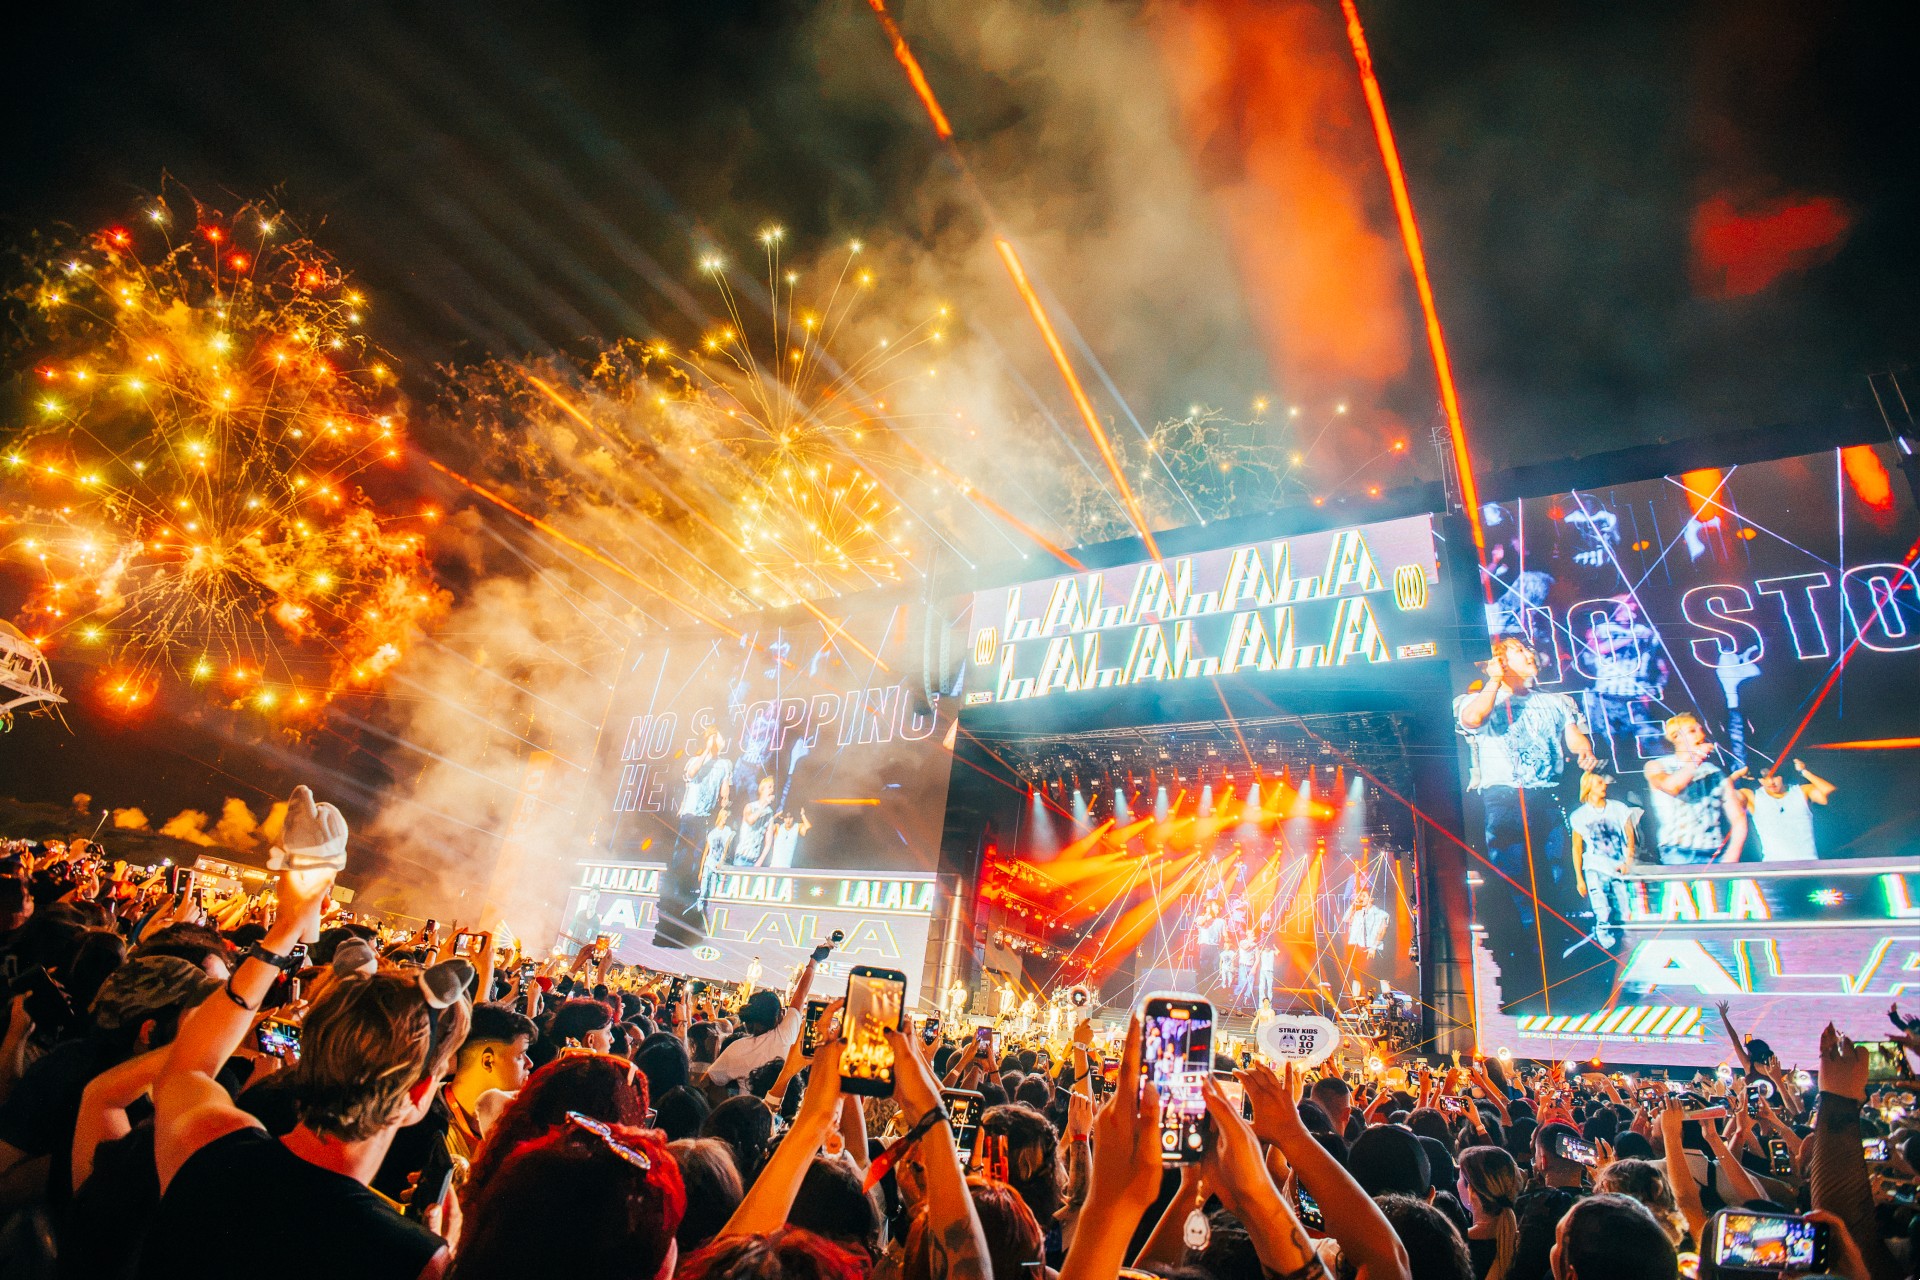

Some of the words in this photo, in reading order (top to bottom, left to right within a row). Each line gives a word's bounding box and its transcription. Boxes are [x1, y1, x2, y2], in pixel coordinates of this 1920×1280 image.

[1003, 529, 1385, 642] LALALALA
[996, 596, 1392, 703] LALALALA
[620, 711, 678, 762] NO
[201, 874, 217, 885] BAR
